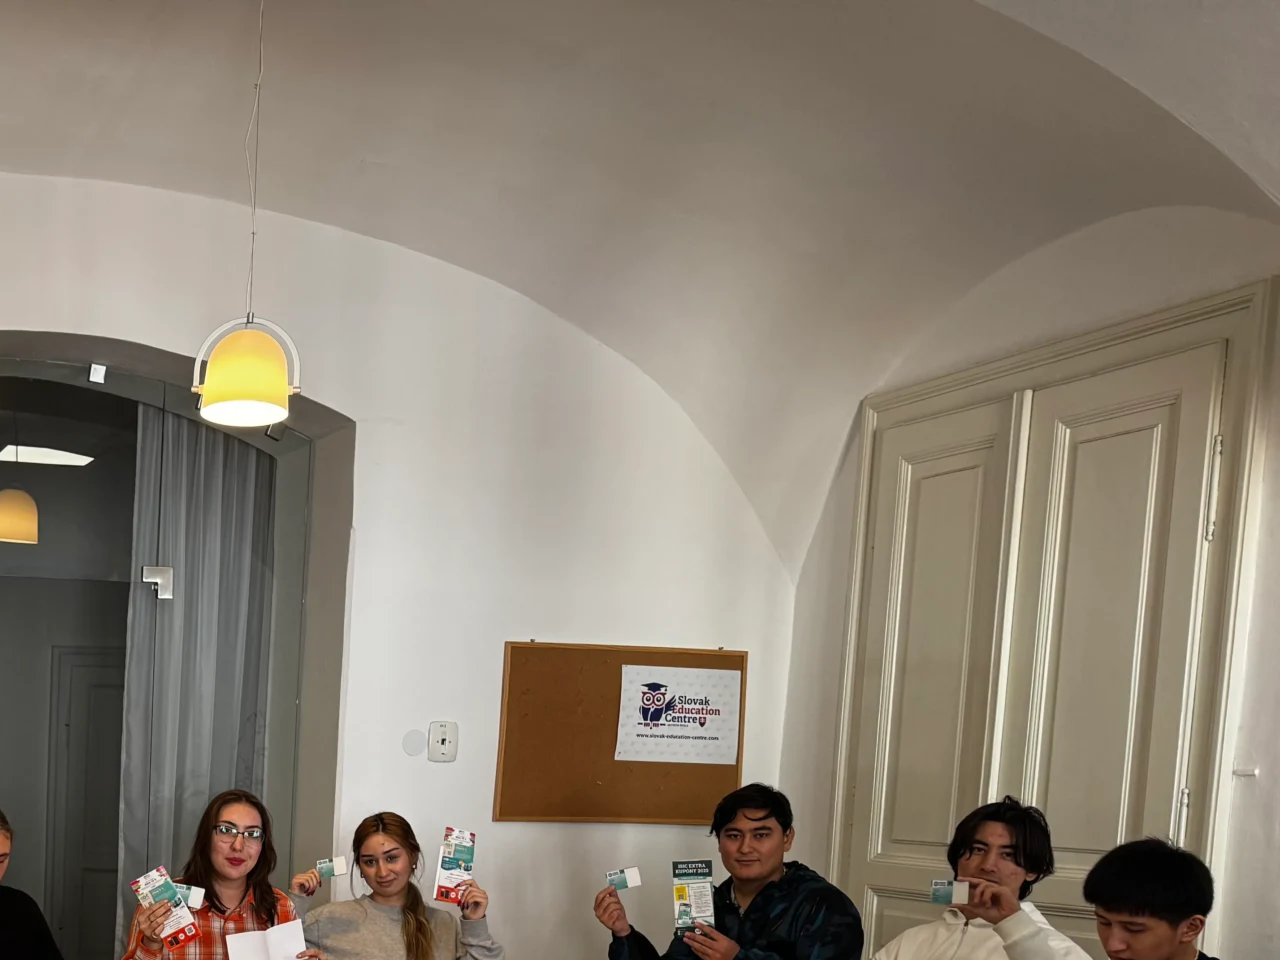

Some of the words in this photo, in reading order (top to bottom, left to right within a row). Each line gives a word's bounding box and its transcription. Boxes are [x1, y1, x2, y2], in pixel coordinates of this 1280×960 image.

[677, 695, 710, 706] Slovak
[671, 705, 721, 716] Education
[664, 713, 698, 724] Centre
[636, 733, 719, 741] www.slovak-education-centre.com
